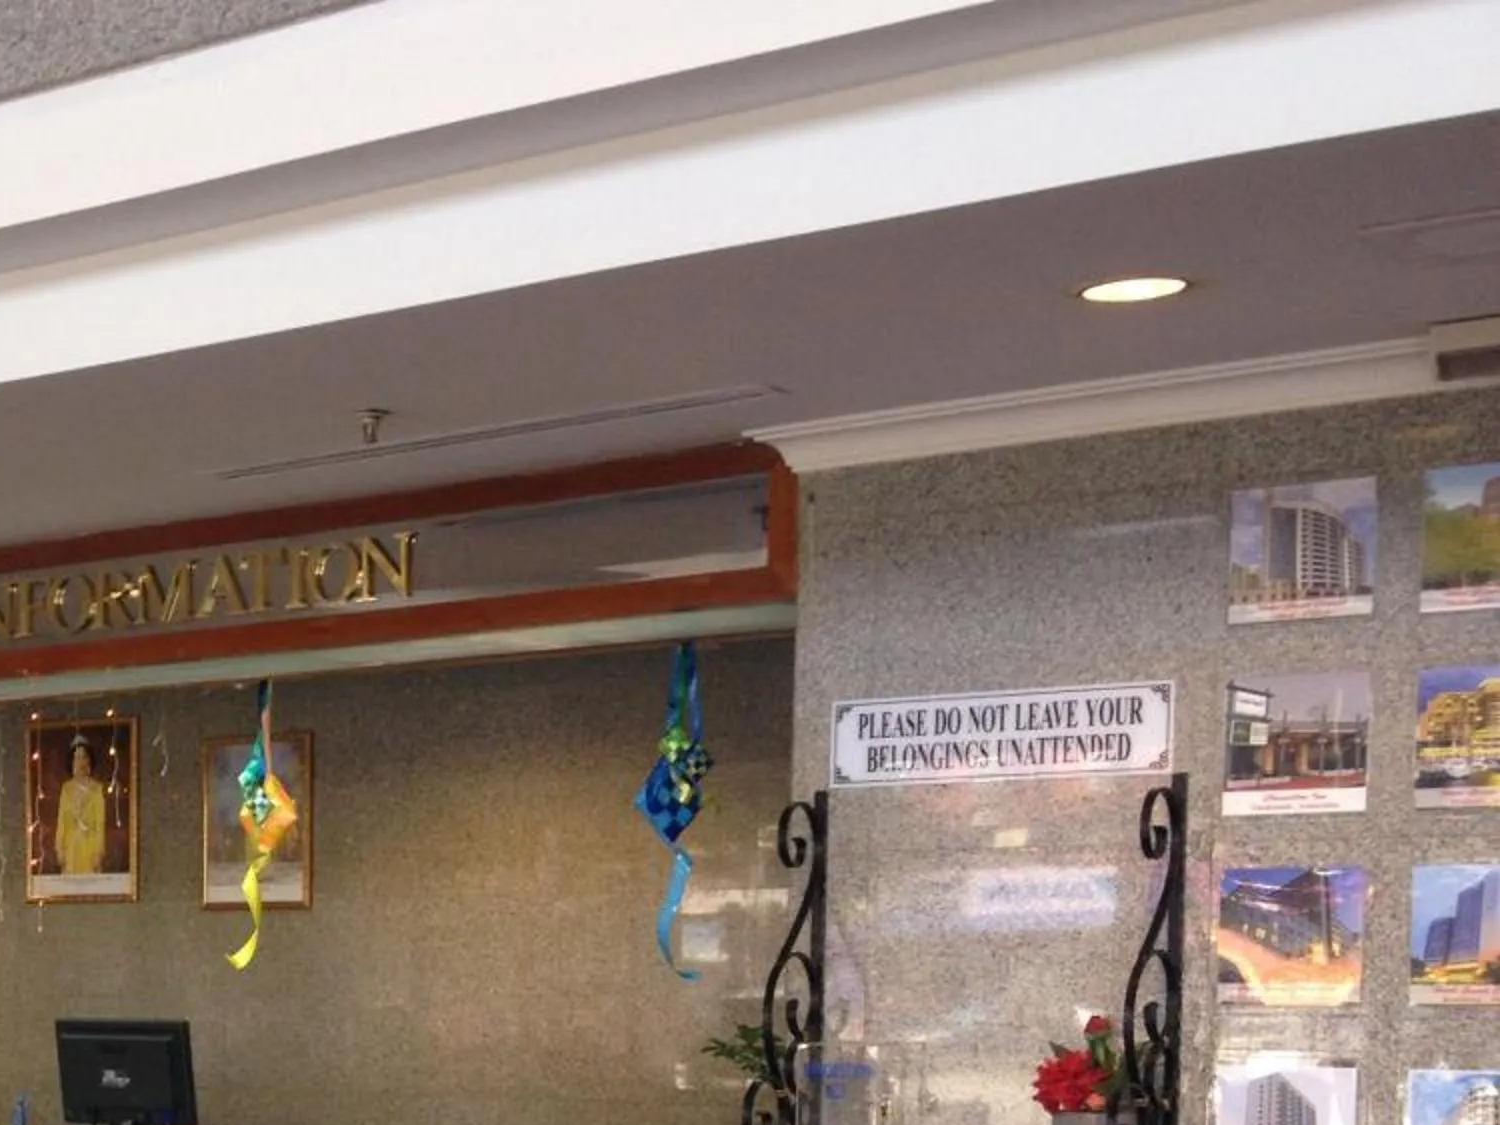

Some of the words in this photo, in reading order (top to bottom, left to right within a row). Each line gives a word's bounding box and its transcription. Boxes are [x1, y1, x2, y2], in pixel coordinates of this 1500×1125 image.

[858, 712, 927, 740] PLEASE
[934, 708, 962, 736] DO
[967, 704, 1010, 733] NOT
[1015, 699, 1079, 731] LEAVE
[1086, 696, 1144, 727] YOUR
[867, 739, 990, 773] BELONGINGS
[997, 734, 1132, 767] UNATTENDED
